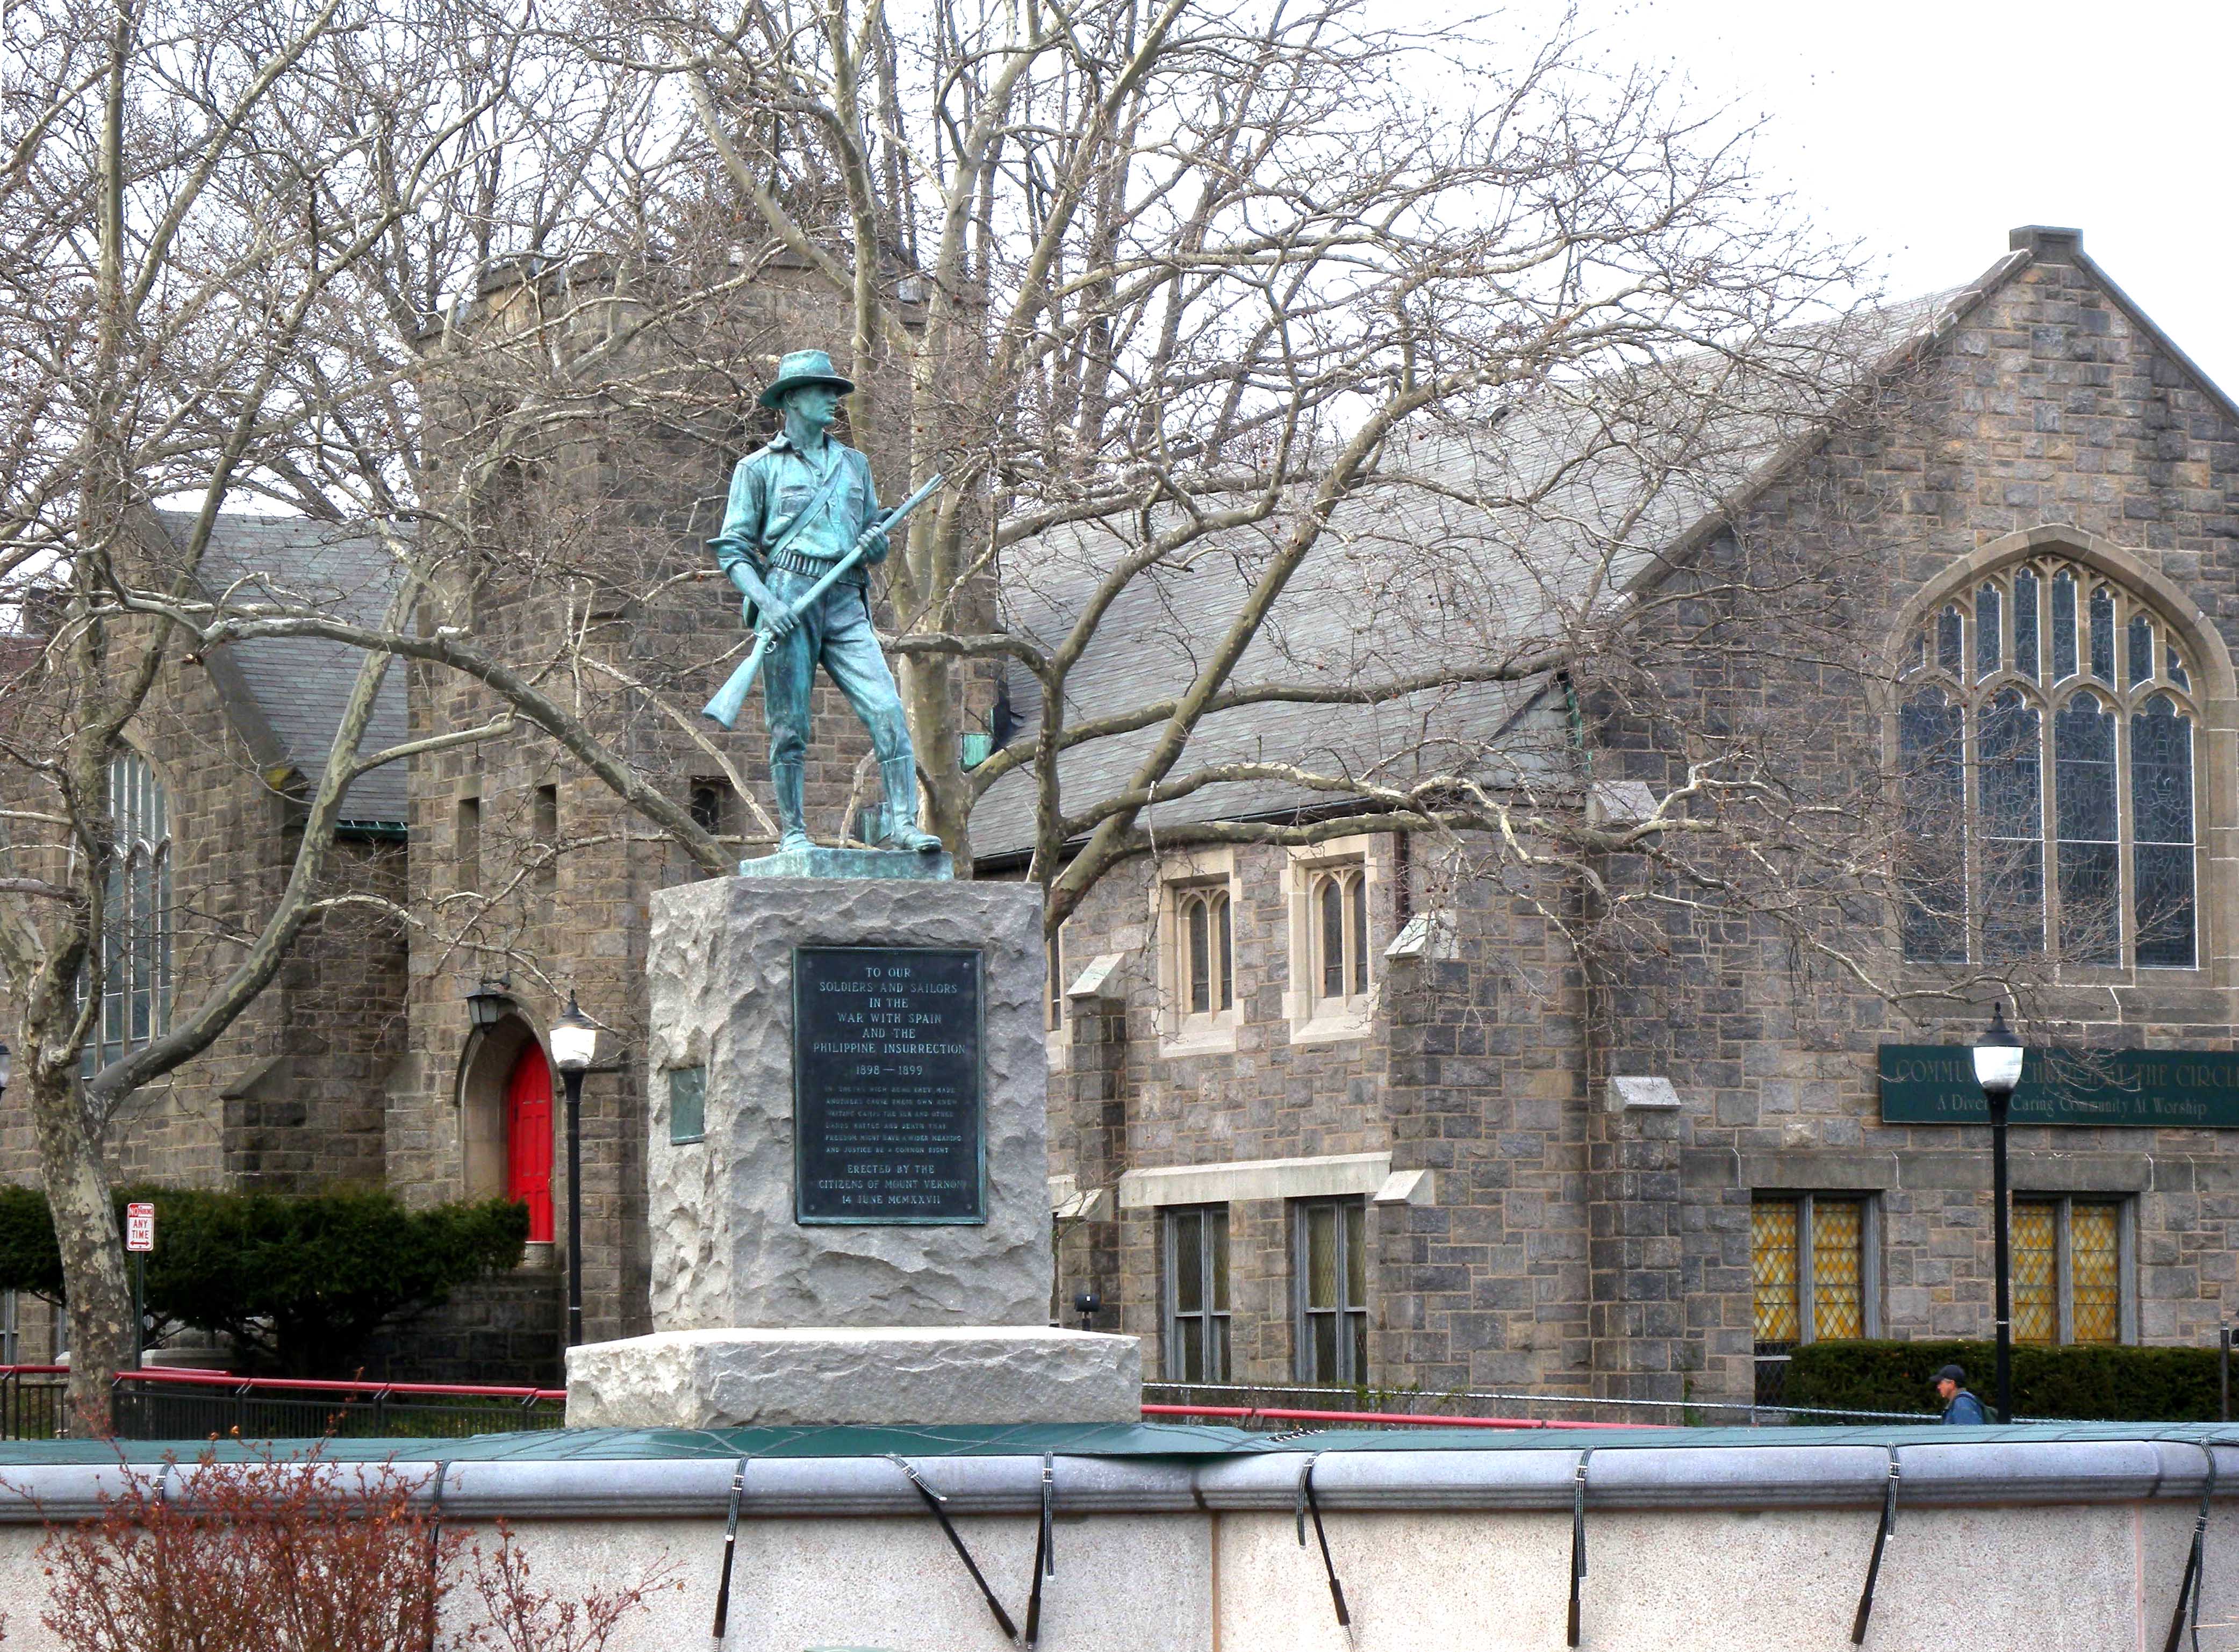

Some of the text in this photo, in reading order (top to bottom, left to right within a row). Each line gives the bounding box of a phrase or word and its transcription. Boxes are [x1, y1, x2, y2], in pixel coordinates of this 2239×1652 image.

[866, 967, 912, 978] TO OUR
[820, 982, 958, 994] SOLDIERS AND SAILORS
[869, 998, 908, 1008] IN THE
[837, 1012, 942, 1024] WAR WITH SPAIN
[862, 1029, 916, 1038] AND THE
[813, 1043, 966, 1054] PHILIPPINE INSURRECTION
[857, 1065, 880, 1075] 1898
[898, 1065, 923, 1076] 1899
[1896, 1059, 1980, 1083] COMMUN
[2135, 1064, 2168, 1086] THE
[1937, 1094, 1946, 1110] A
[2011, 1094, 2055, 1117] Caring
[2134, 1097, 2148, 1114] At
[2153, 1097, 2206, 1120] Worship
[847, 1165, 935, 1174] ERECTED BY THE
[819, 1180, 863, 1189] CITIZENS
[867, 1180, 880, 1189] OF
[885, 1180, 918, 1189] MOUNT
[842, 1195, 941, 1204] 14 JUNE MCMXXVII
[129, 1206, 138, 1216] NO
[133, 1219, 148, 1229] ANY
[132, 1230, 149, 1239] TIME
